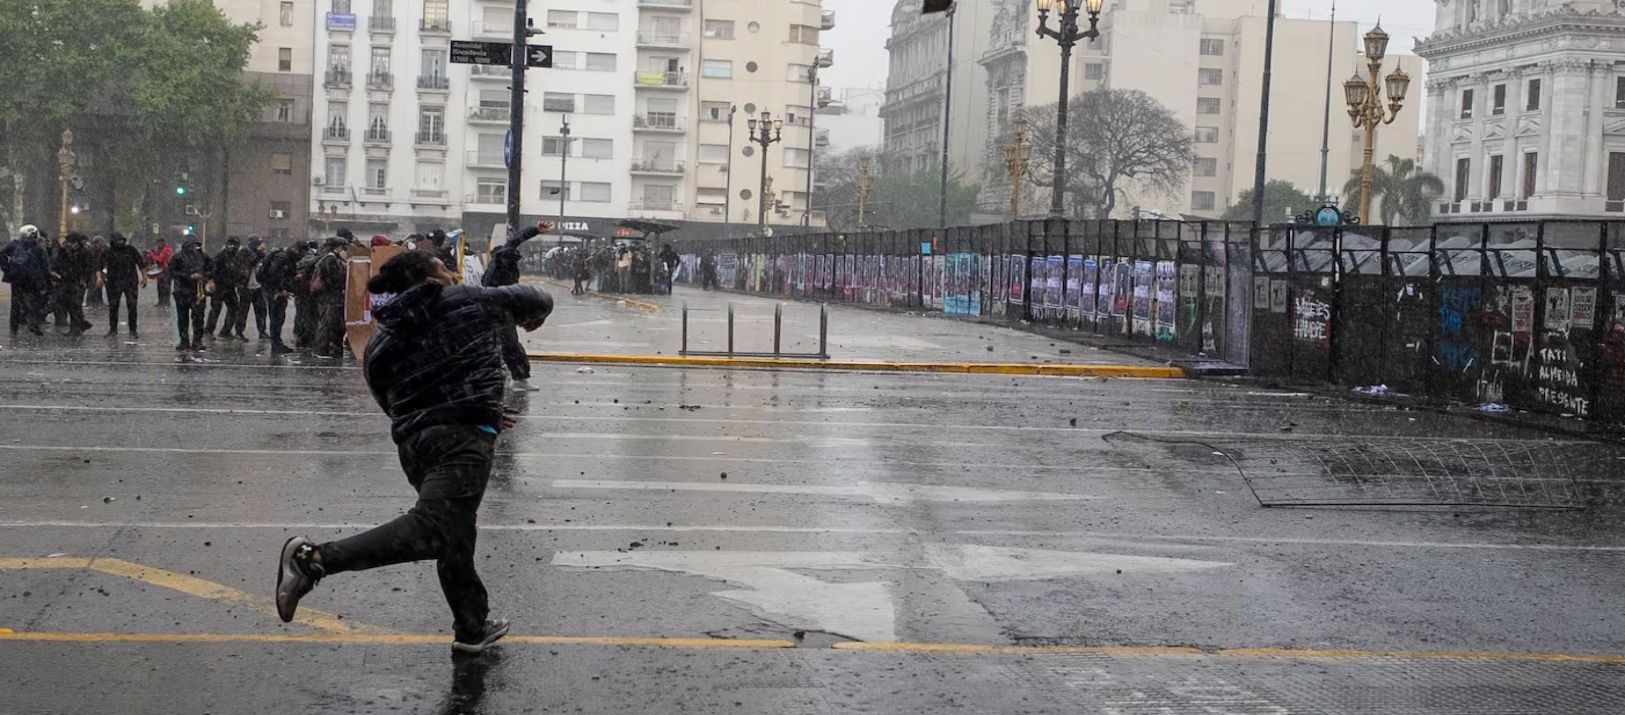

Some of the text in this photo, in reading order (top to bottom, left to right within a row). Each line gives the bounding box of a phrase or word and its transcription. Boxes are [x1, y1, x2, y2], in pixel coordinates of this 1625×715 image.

[452, 49, 487, 57] Rivadavia
[558, 222, 589, 231] PIZZA
[1540, 348, 1567, 362] TATI
[1539, 387, 1590, 415] PRESENTE
